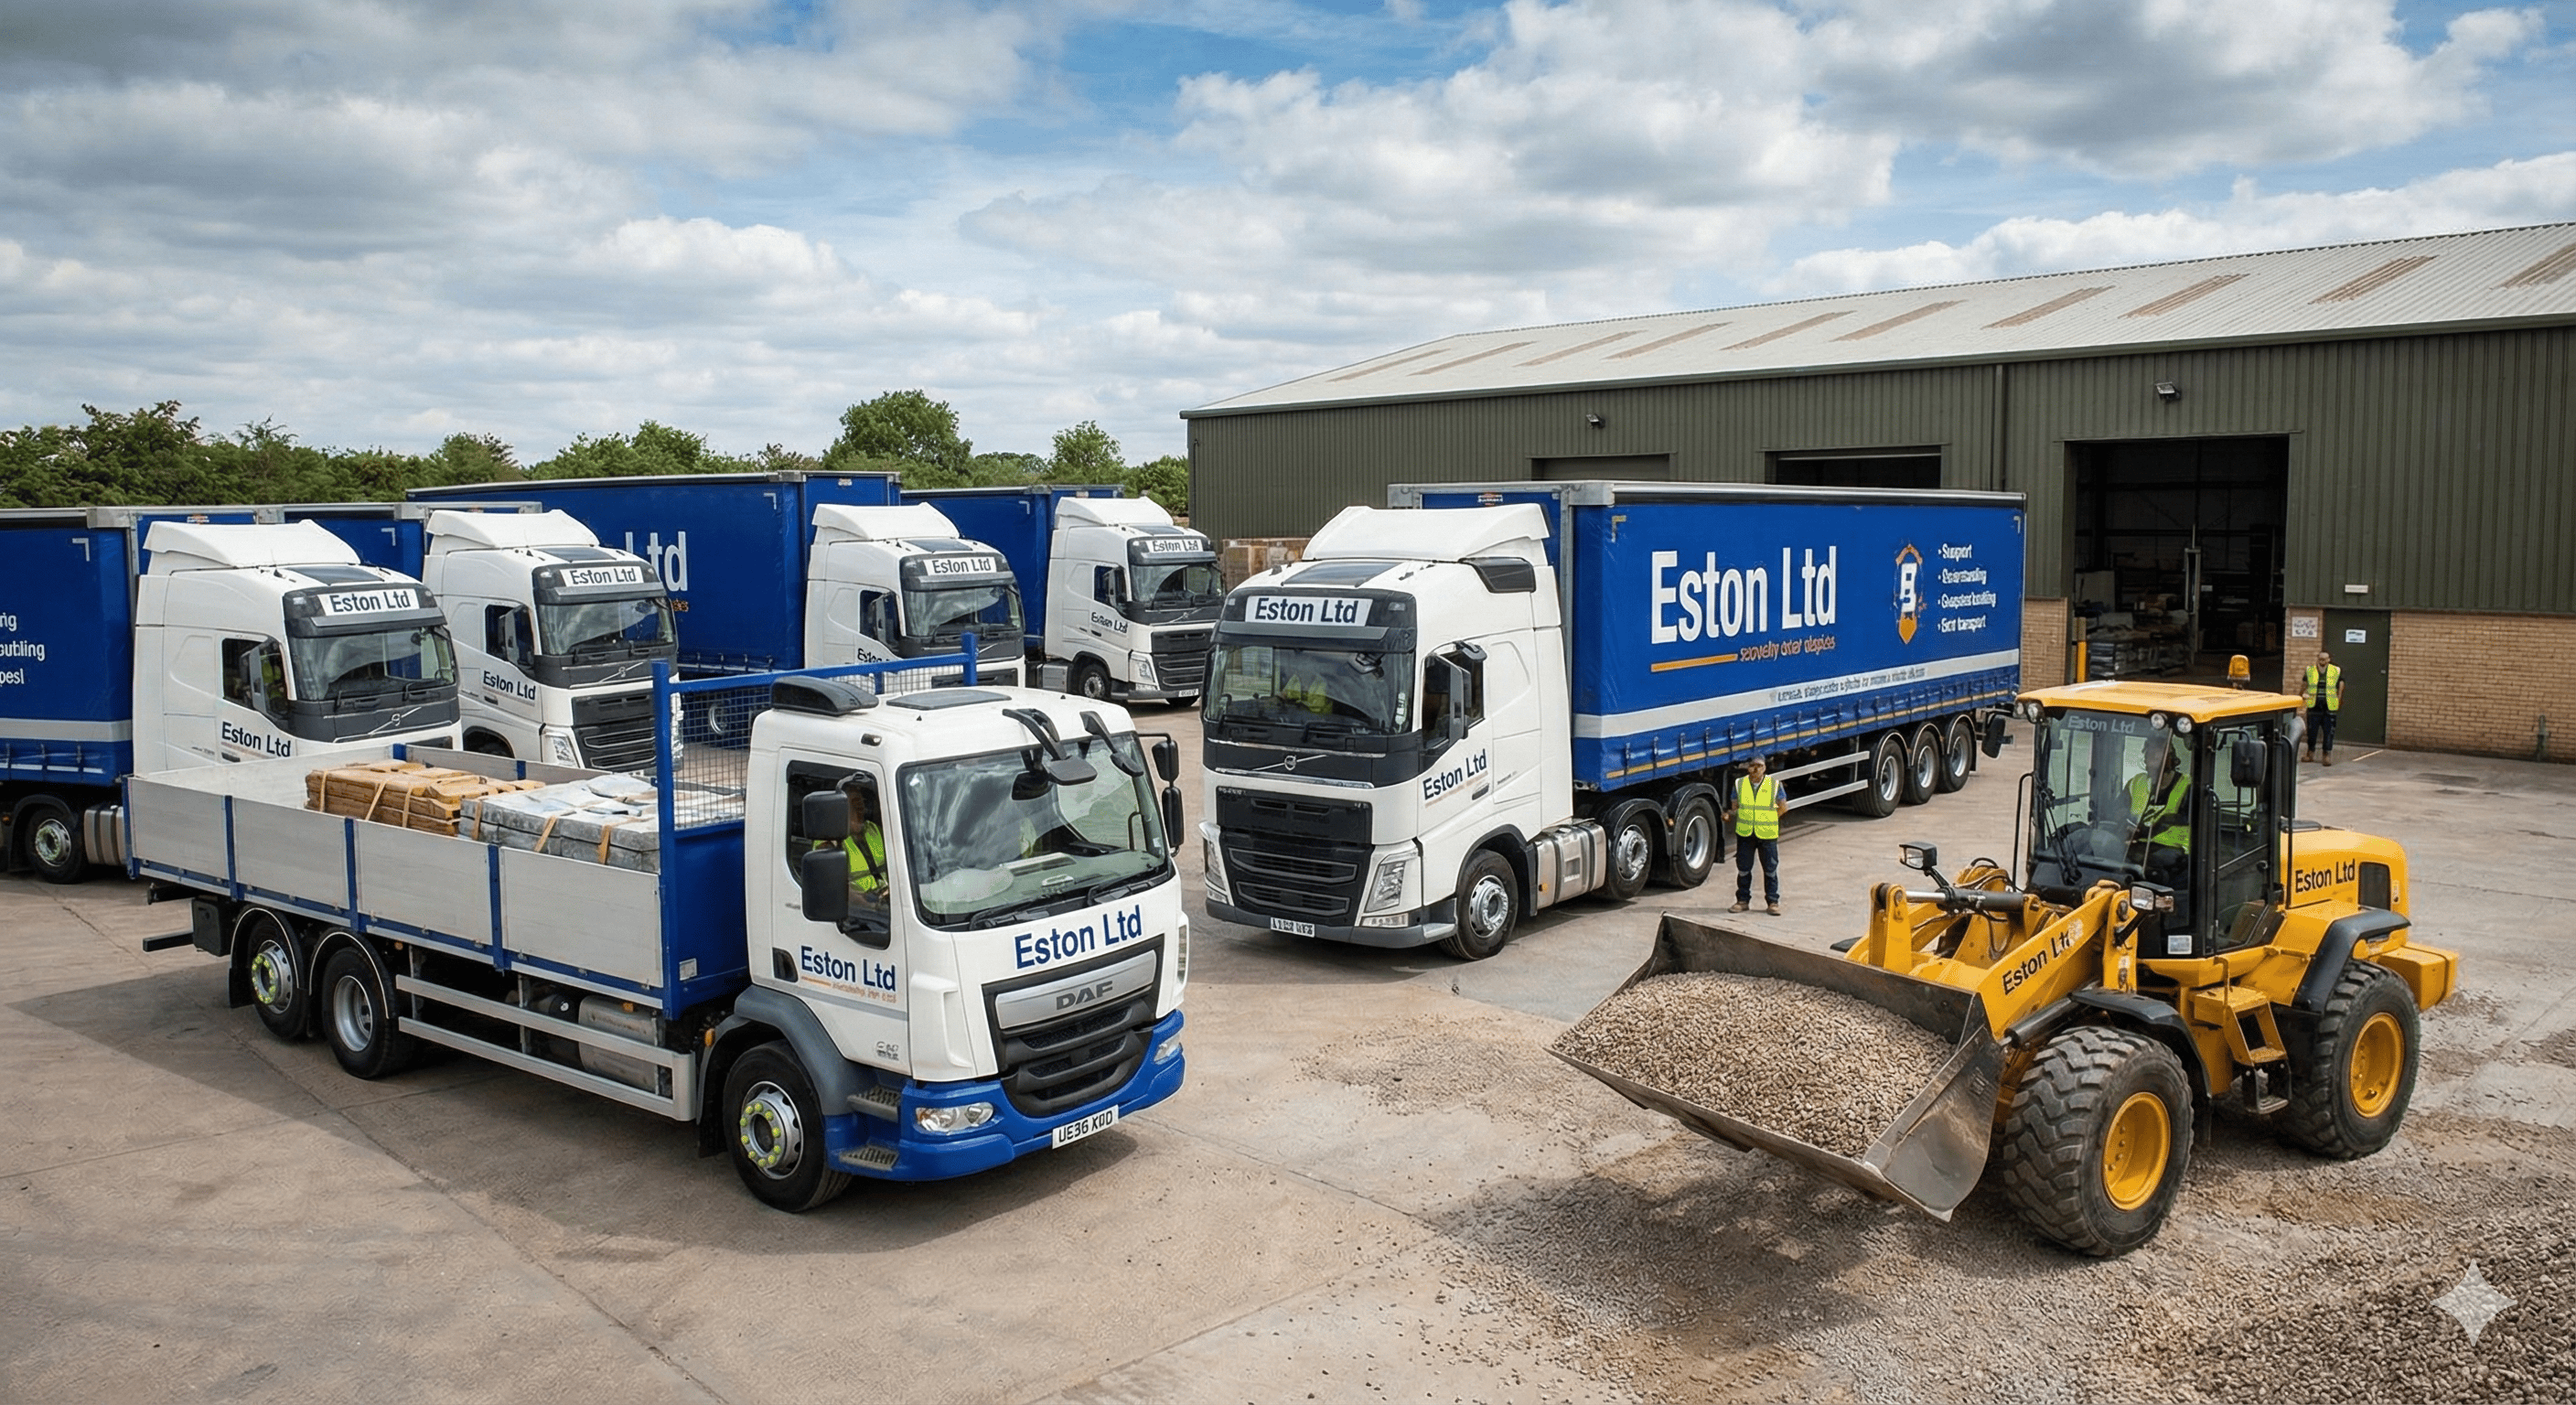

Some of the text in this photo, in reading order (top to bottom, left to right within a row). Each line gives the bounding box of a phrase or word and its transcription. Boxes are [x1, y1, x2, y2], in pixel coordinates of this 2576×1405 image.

[569, 567, 637, 585] Eston Ltd
[971, 558, 992, 572] Ltd
[329, 590, 412, 613] Eston Ltd
[1254, 597, 1359, 624] Eston Ltd
[1651, 545, 1837, 645] Eston Ltd
[221, 721, 291, 757] Eston Ltd
[2111, 718, 2136, 735] Ltd
[1422, 767, 1464, 800] Eston
[1465, 748, 1487, 778] Ltd
[2295, 858, 2356, 894] Eston Ltd
[1014, 904, 1143, 970] Eston Ltd
[800, 945, 856, 983] Eston
[863, 959, 896, 992] Ltd
[2002, 950, 2048, 996] Eston
[1056, 980, 1113, 1011] DAF
[1058, 1119, 1089, 1143] UE36
